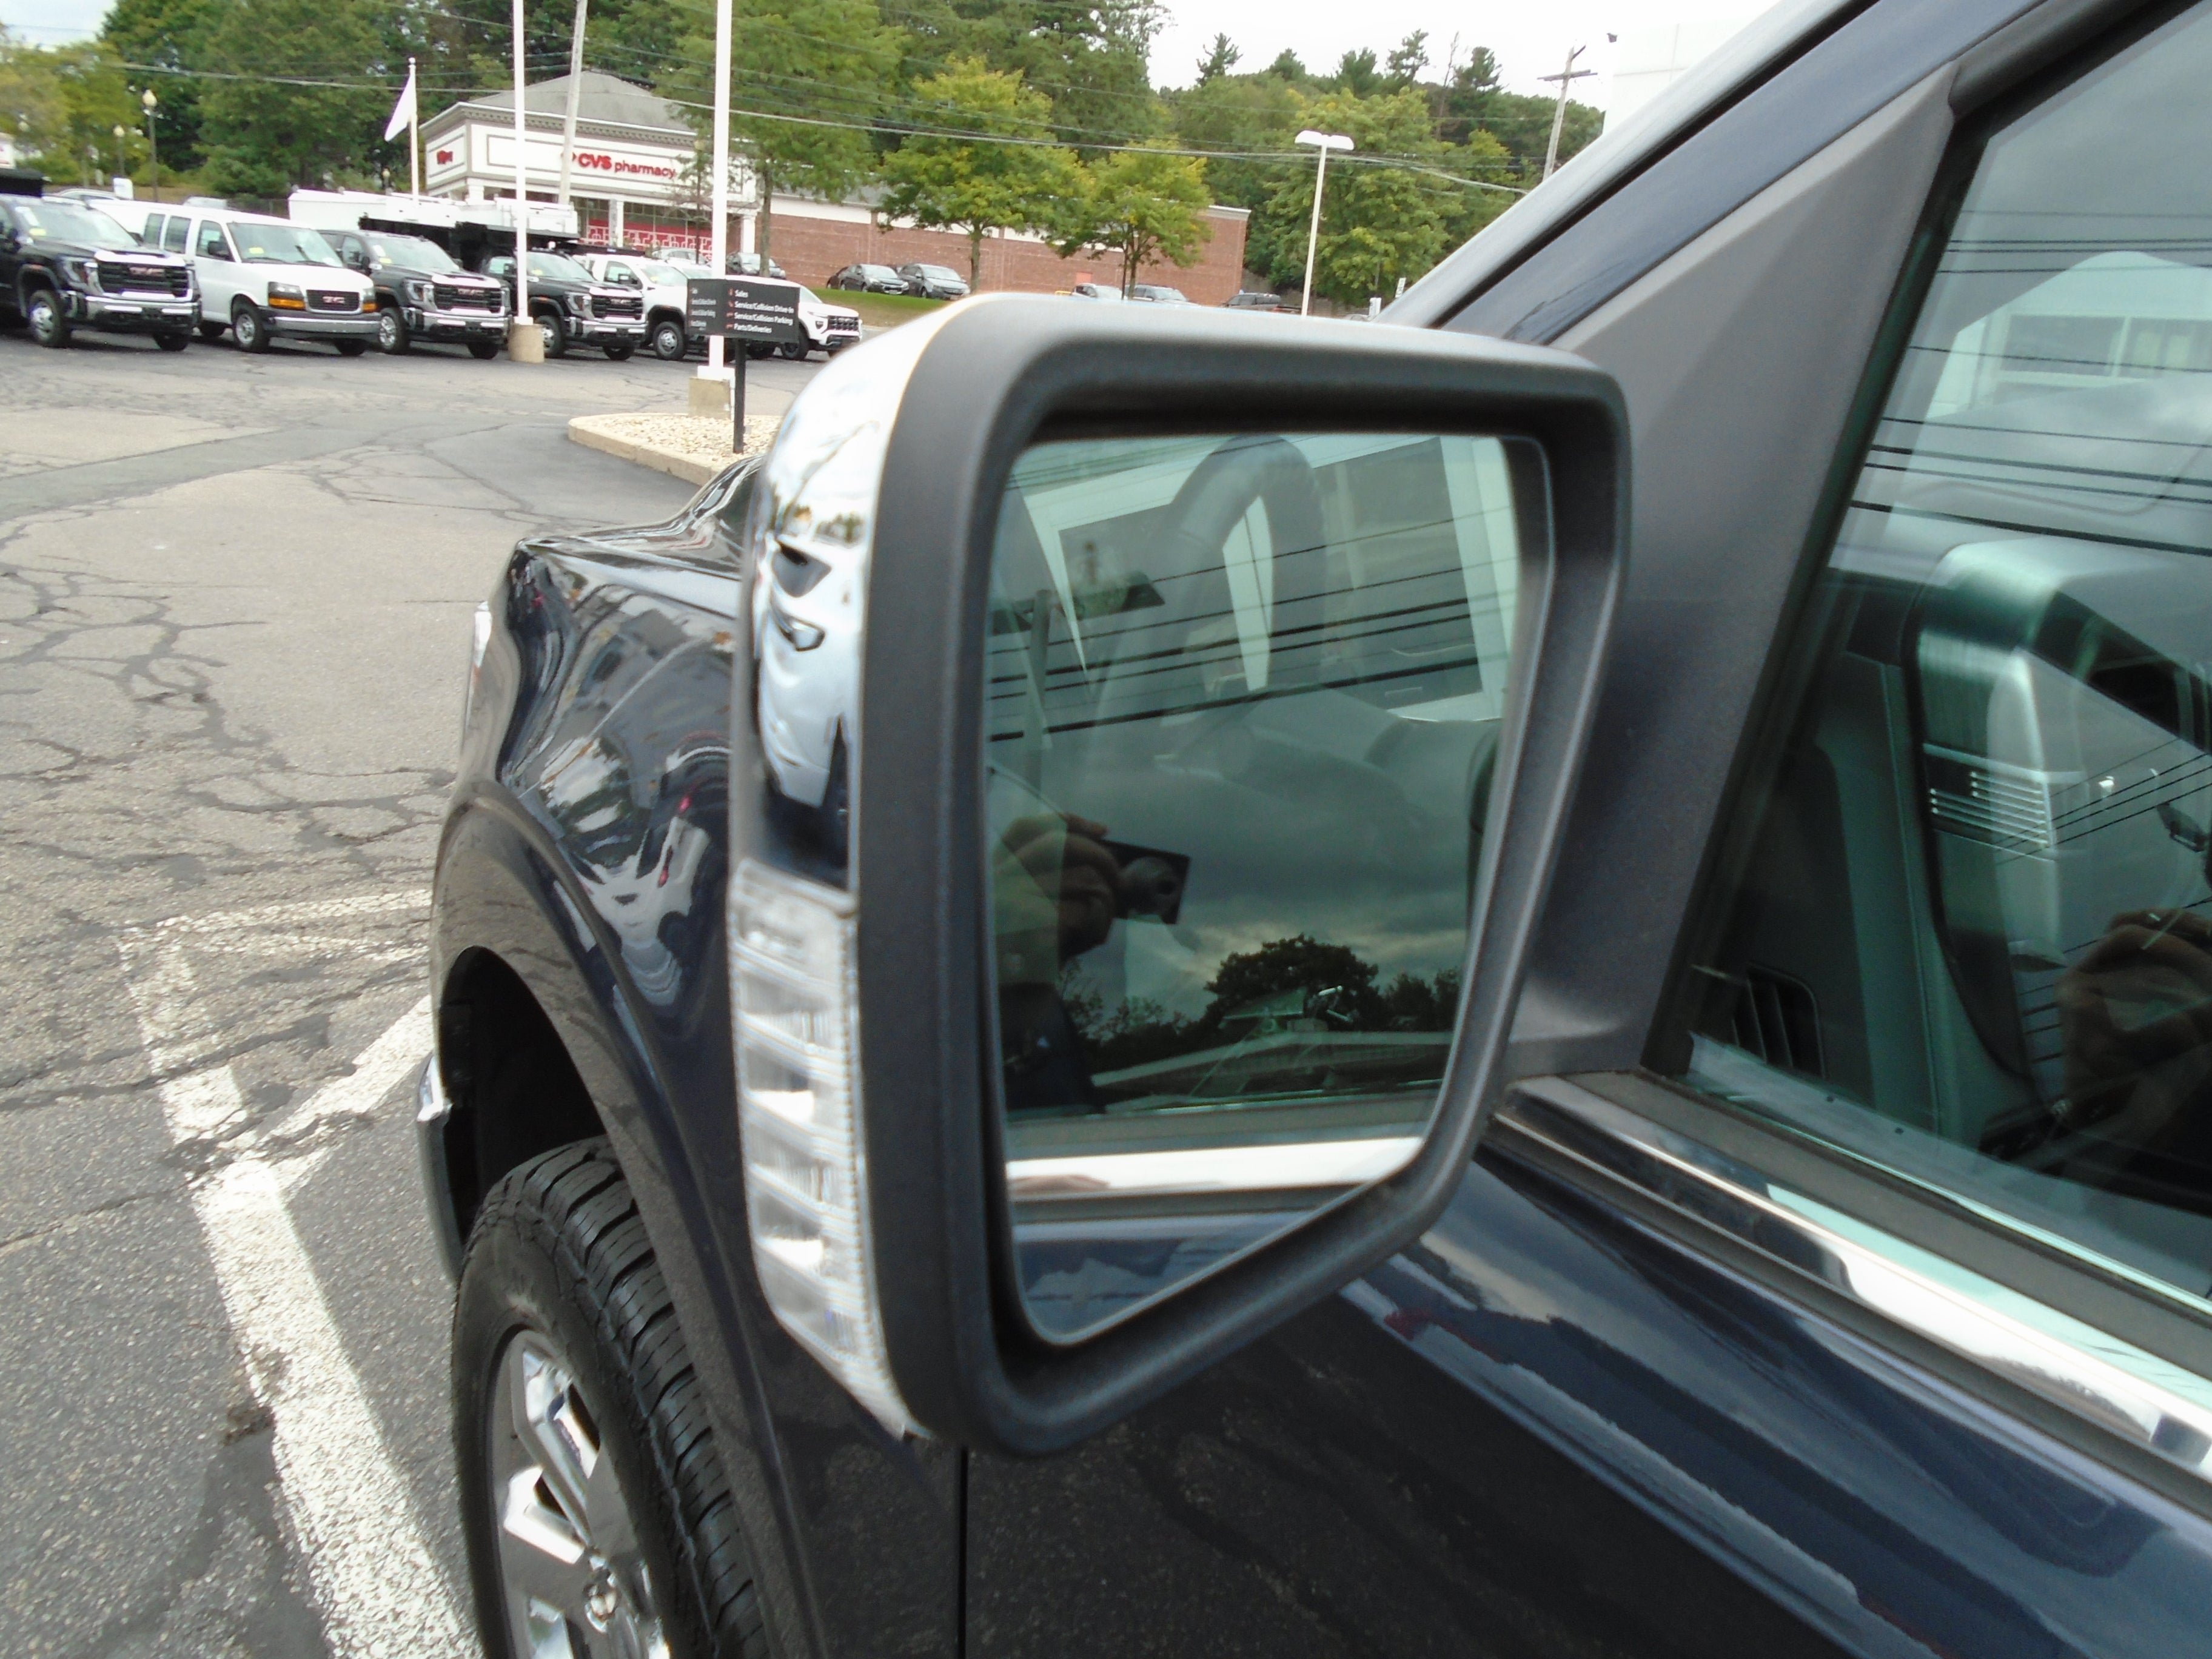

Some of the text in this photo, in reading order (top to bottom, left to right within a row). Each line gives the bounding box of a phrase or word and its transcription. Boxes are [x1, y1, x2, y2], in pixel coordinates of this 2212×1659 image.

[578, 153, 675, 179] CVS pharmacy
[734, 289, 749, 298] Sales
[734, 301, 774, 312] Service/Collision
[734, 312, 794, 326] Service/Collision Parking
[734, 323, 773, 334] Parts/Deliveries
